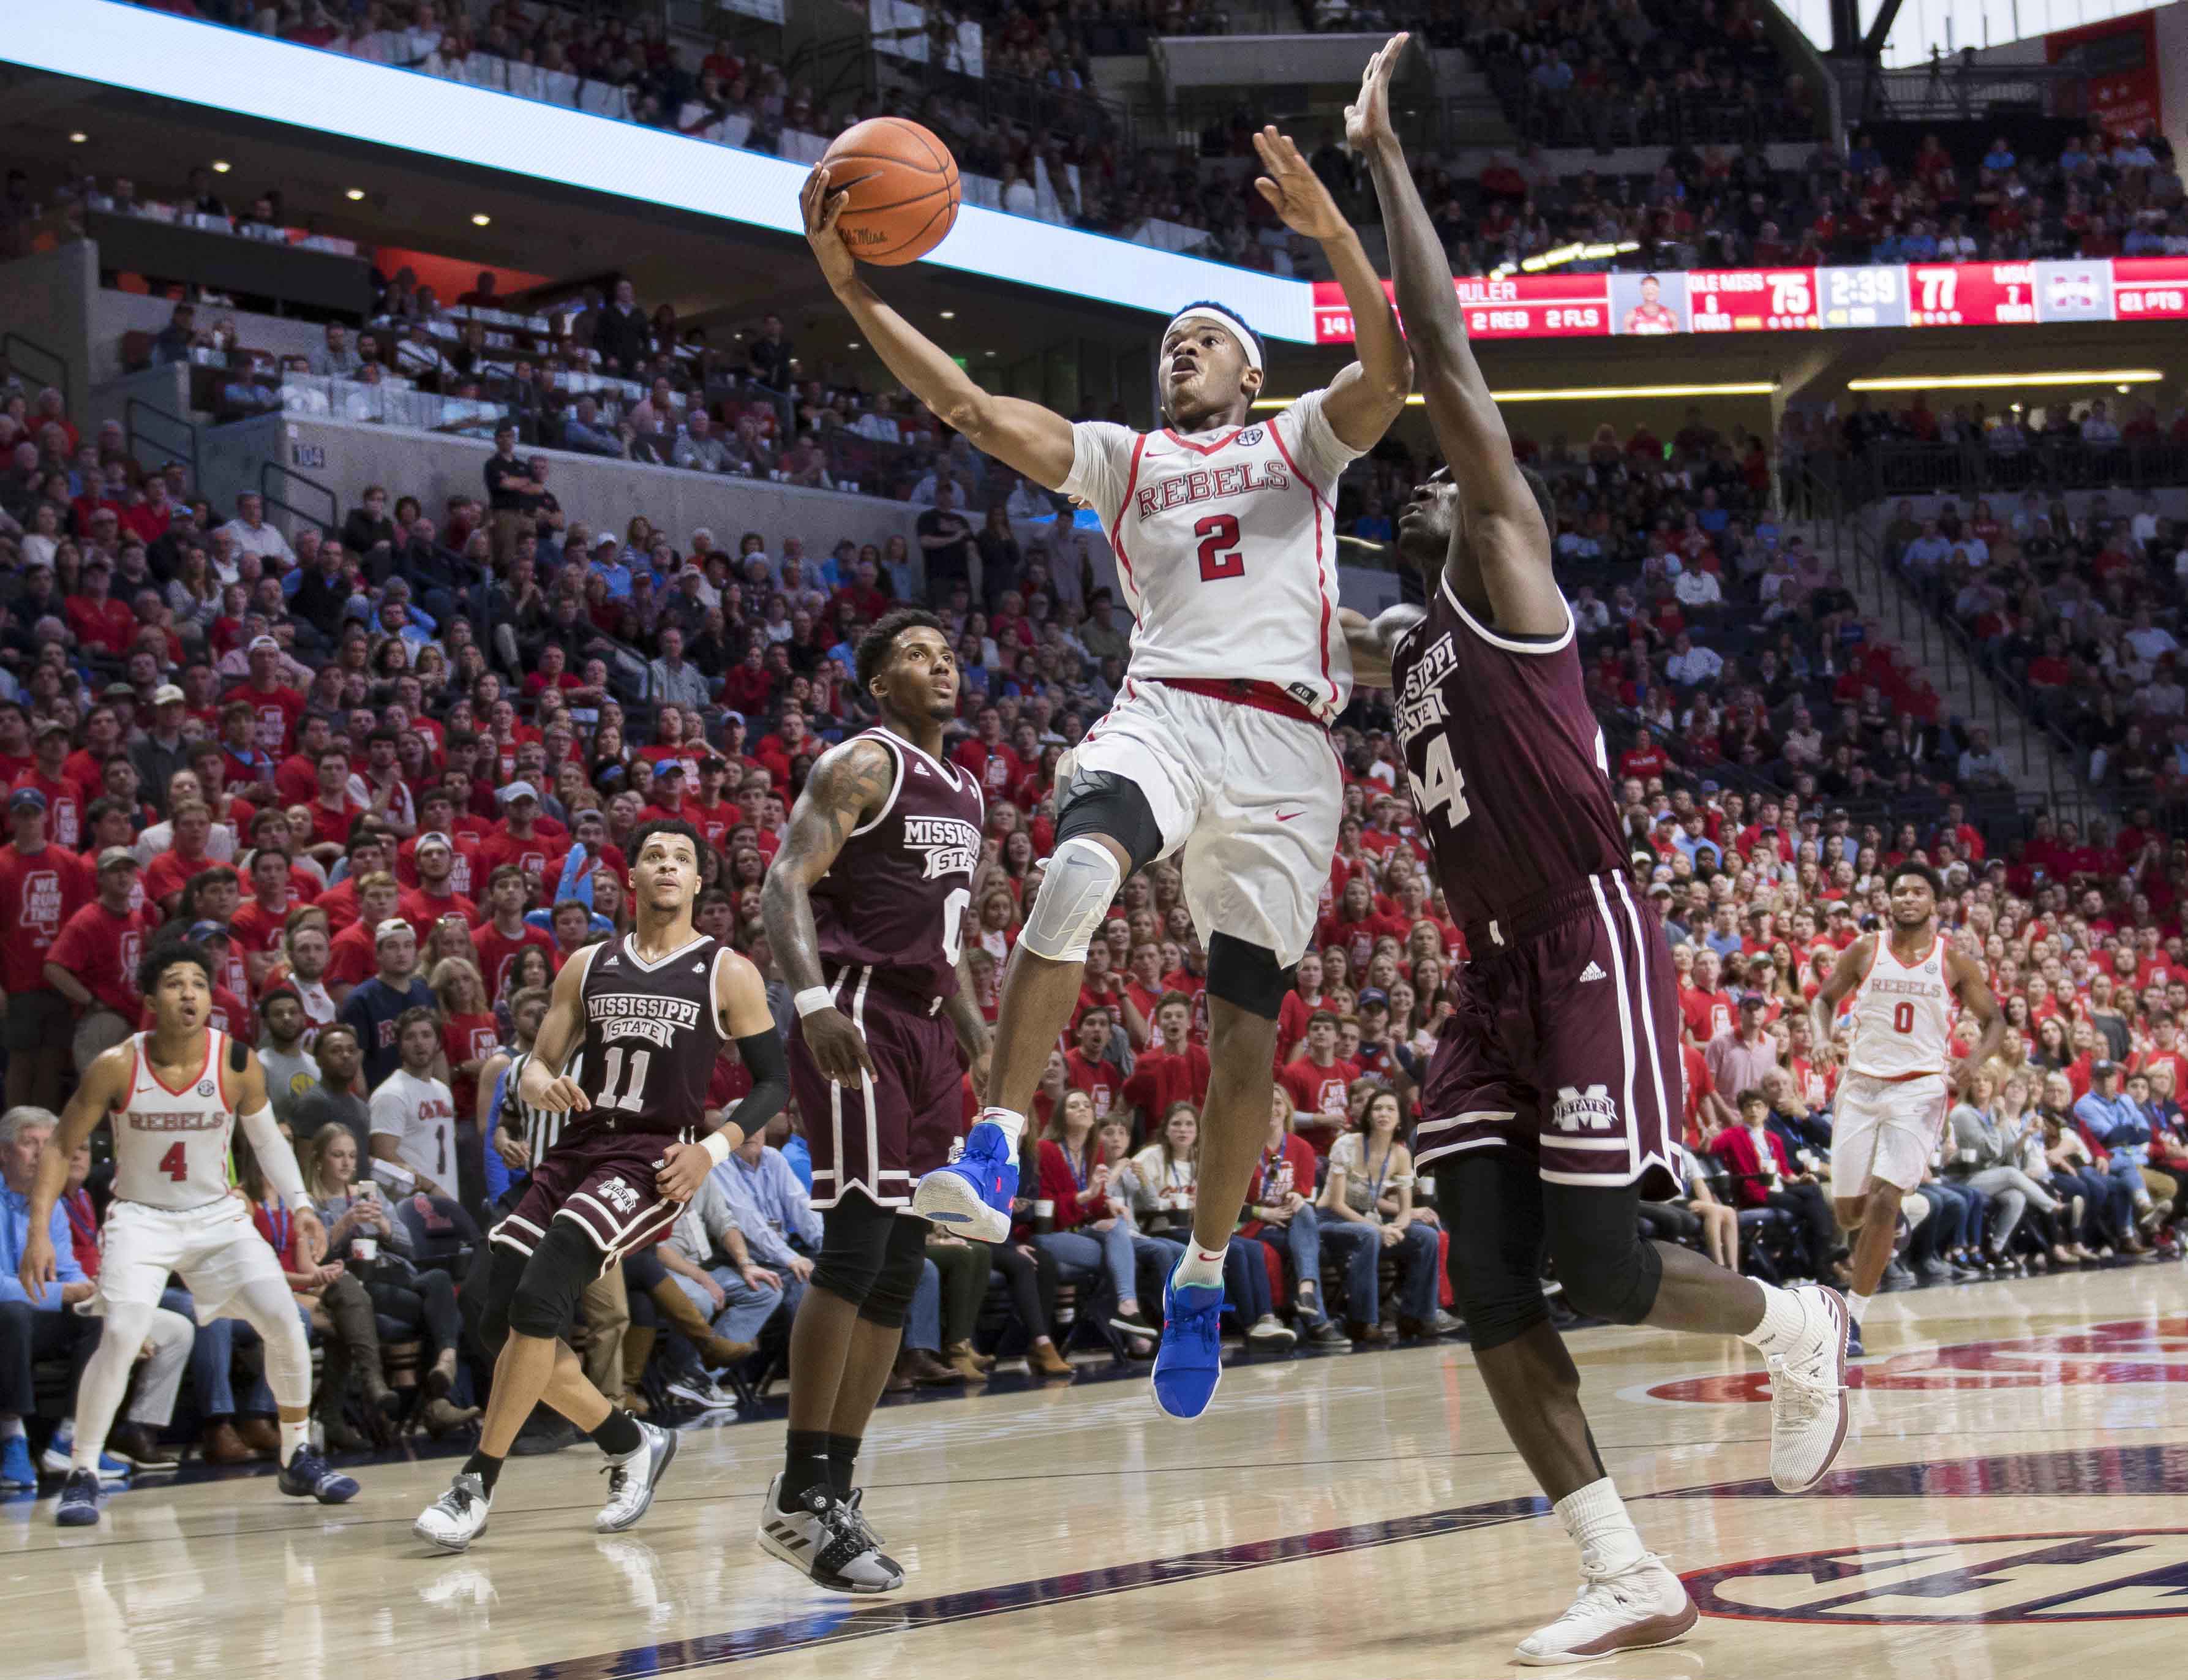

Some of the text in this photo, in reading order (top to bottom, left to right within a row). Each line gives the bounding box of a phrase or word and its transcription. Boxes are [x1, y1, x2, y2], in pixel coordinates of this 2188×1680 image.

[1688, 273, 1764, 292] OLE MISS
[1766, 273, 1811, 314] 75
[1831, 270, 1895, 304] 2:39
[1917, 268, 1958, 310] 77
[2119, 291, 2184, 311] 21 PTS
[1322, 317, 1347, 335] 14
[1472, 311, 1529, 331] 2 REB
[1546, 308, 1599, 328] 2 FLS
[1136, 460, 1290, 522] REBELS
[1194, 514, 1245, 582] 2
[1871, 978, 1942, 998] REBELS
[588, 997, 701, 1026] MISSISSIPPI
[1894, 1001, 1914, 1034] 0
[612, 1020, 660, 1039] STATE
[595, 1047, 650, 1113] 11
[1564, 1099, 1605, 1114] STATE
[128, 1111, 225, 1131] REBELS
[159, 1142, 187, 1181] 4
[434, 1124, 446, 1175] 1
[605, 1183, 631, 1207] STATE
